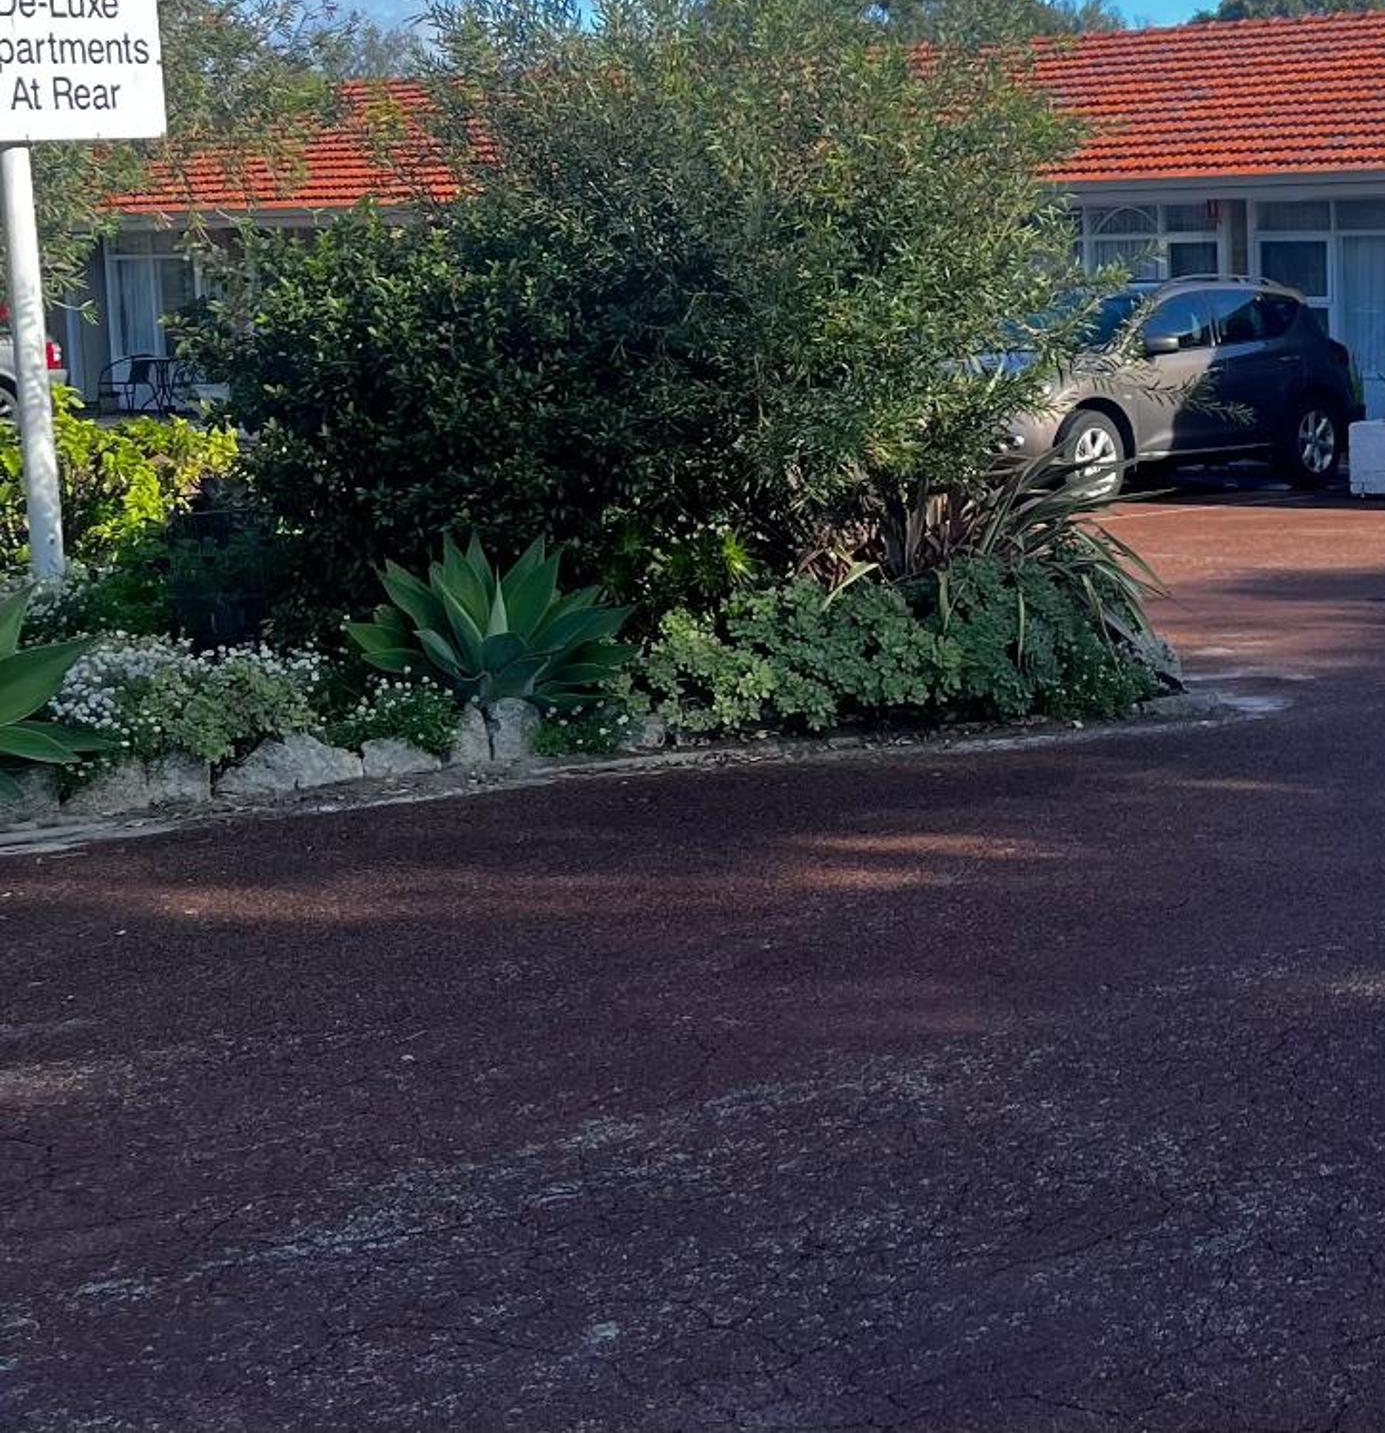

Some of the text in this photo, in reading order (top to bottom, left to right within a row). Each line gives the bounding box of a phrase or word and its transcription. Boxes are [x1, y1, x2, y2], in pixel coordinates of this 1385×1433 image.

[0, 32, 150, 72] partments
[11, 76, 121, 110] At Rear
